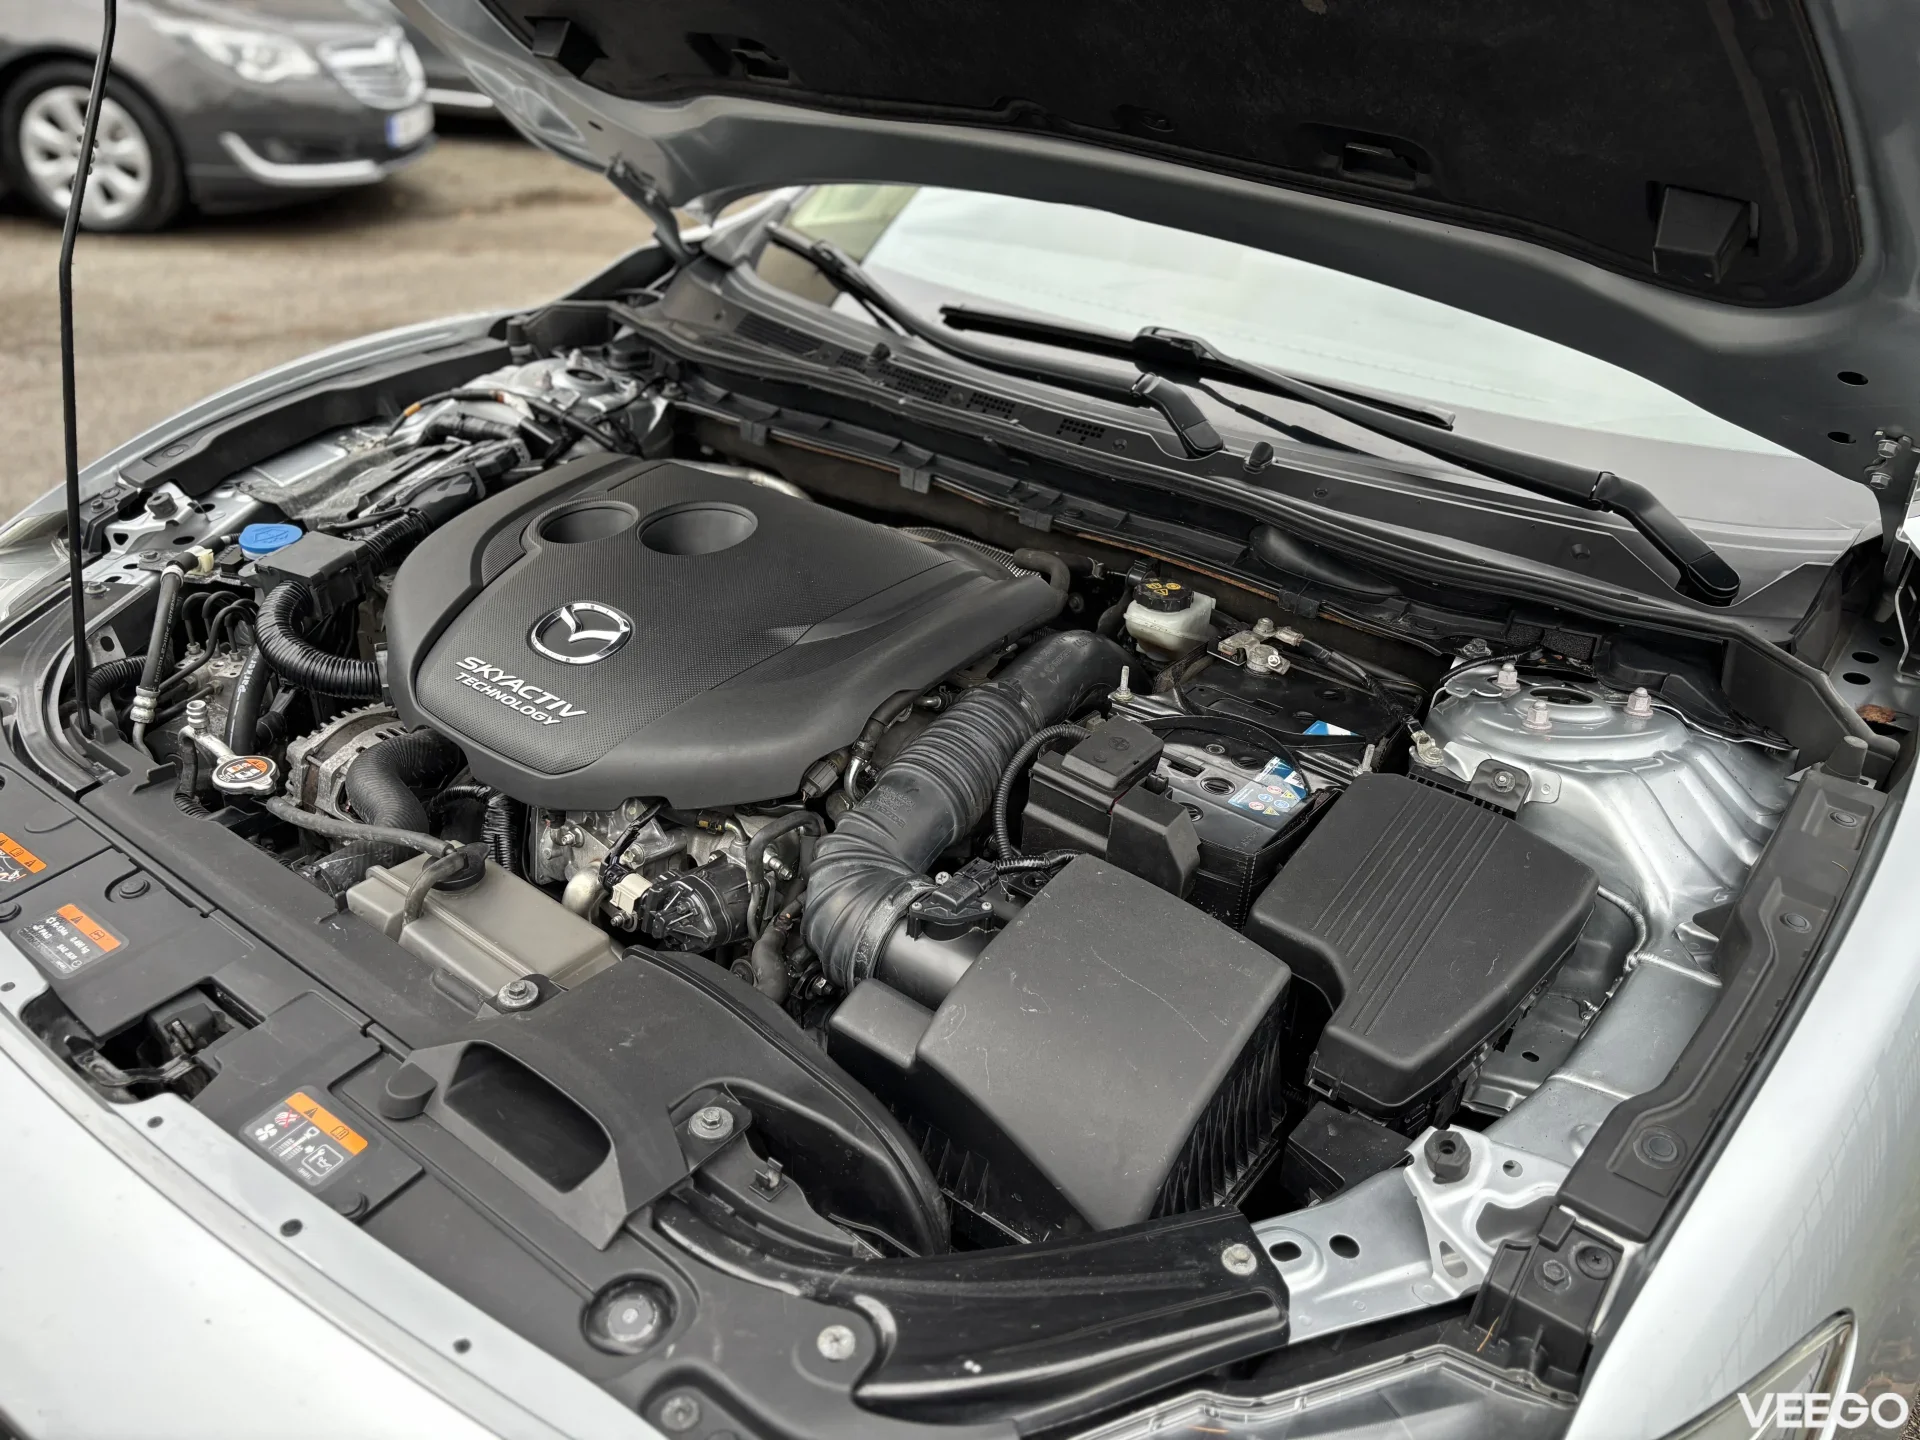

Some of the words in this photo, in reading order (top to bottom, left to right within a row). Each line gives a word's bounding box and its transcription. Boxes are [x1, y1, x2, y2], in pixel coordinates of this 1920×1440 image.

[238, 660, 257, 693] Parker
[455, 672, 561, 725] TECHNOLOGY
[456, 657, 587, 717] SKYACTIV
